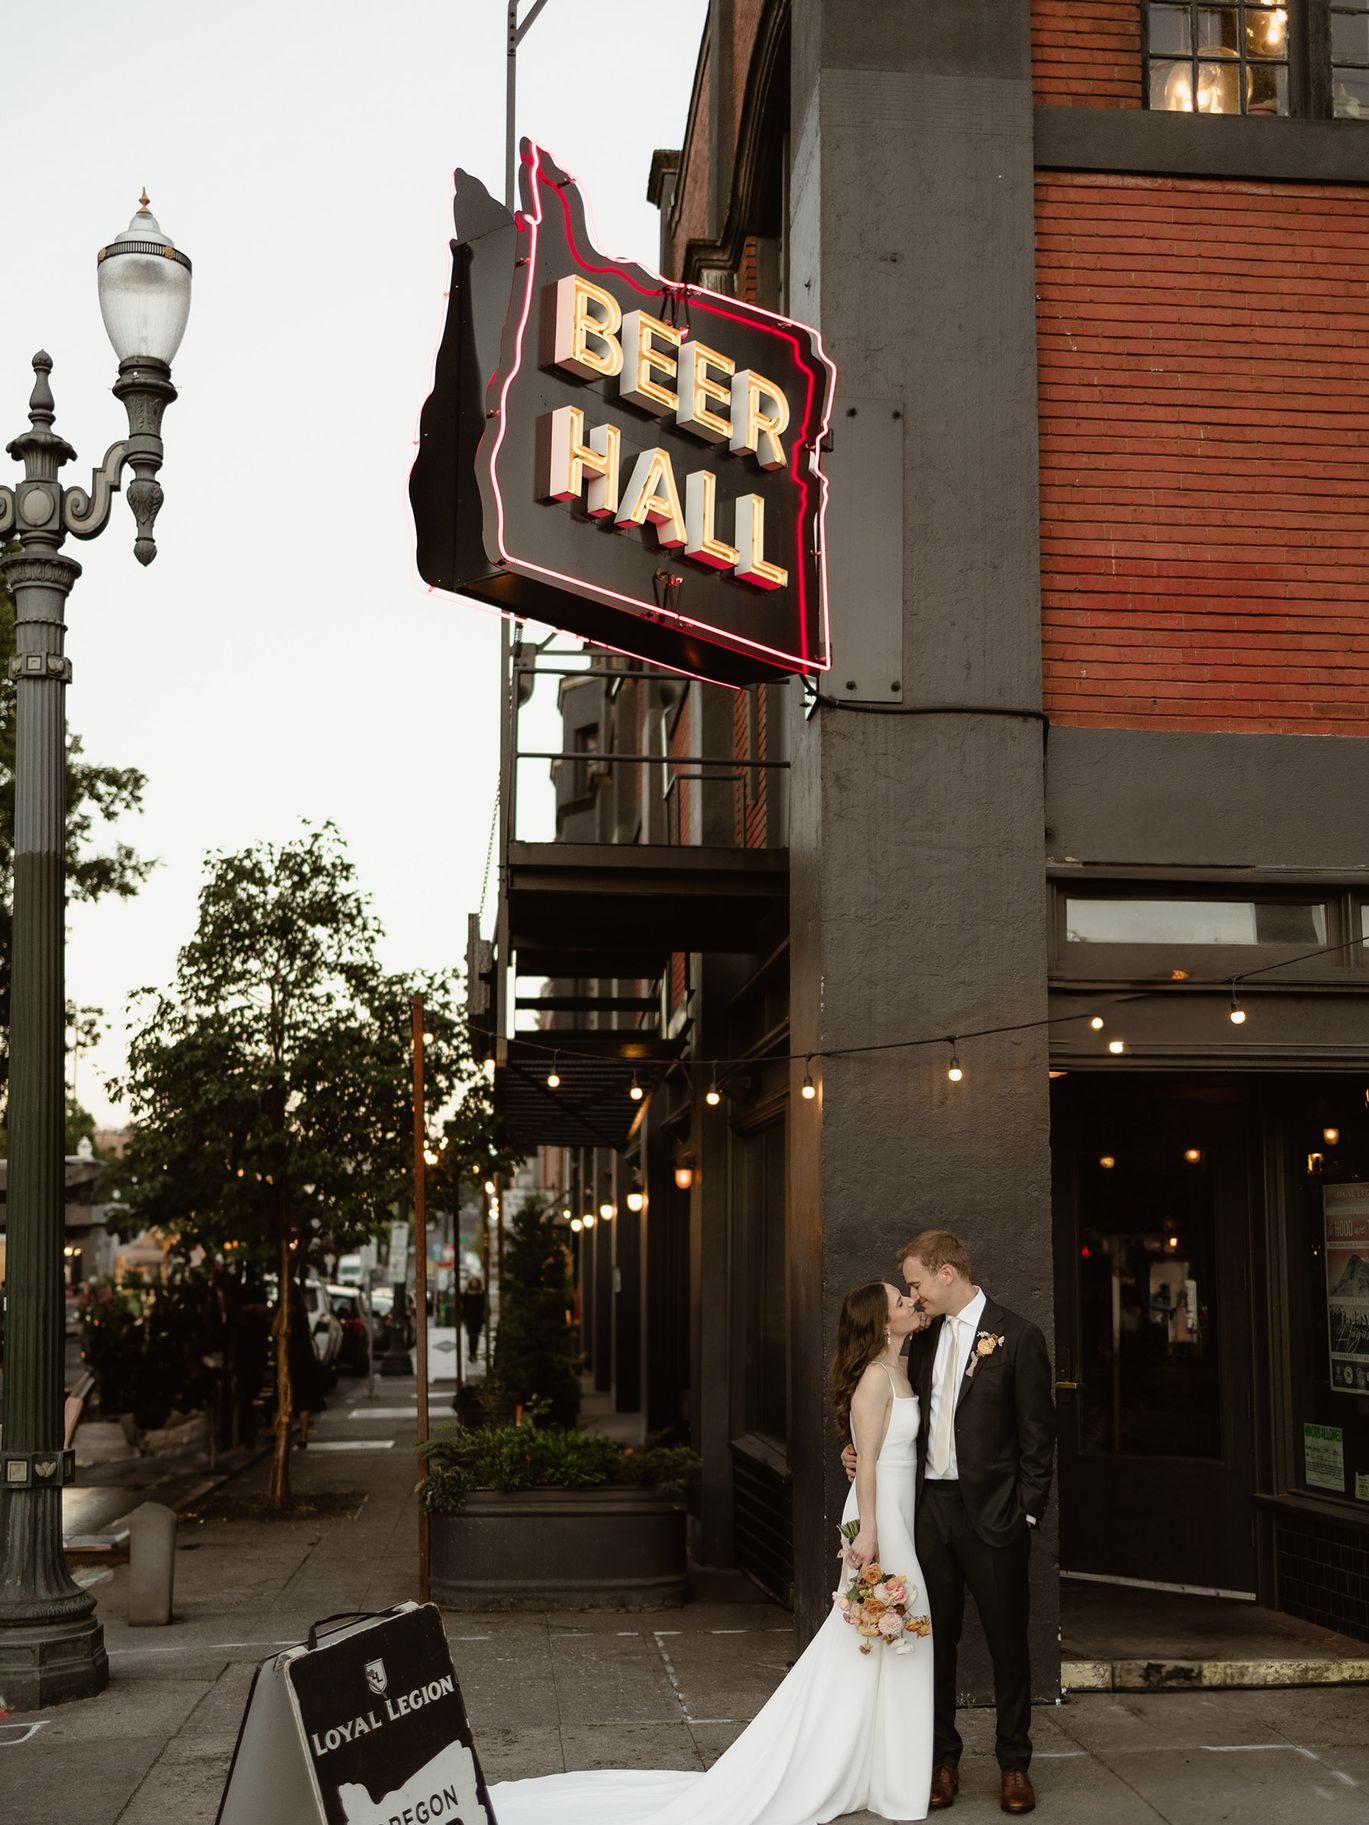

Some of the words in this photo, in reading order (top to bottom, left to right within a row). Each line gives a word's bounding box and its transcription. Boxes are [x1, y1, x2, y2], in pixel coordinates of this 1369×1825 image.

[555, 274, 790, 471] BEER
[550, 405, 788, 591] HALL
[311, 1711, 382, 1757] LOYAL
[384, 1674, 455, 1721] LEGION
[378, 1785, 458, 1825] REGON
